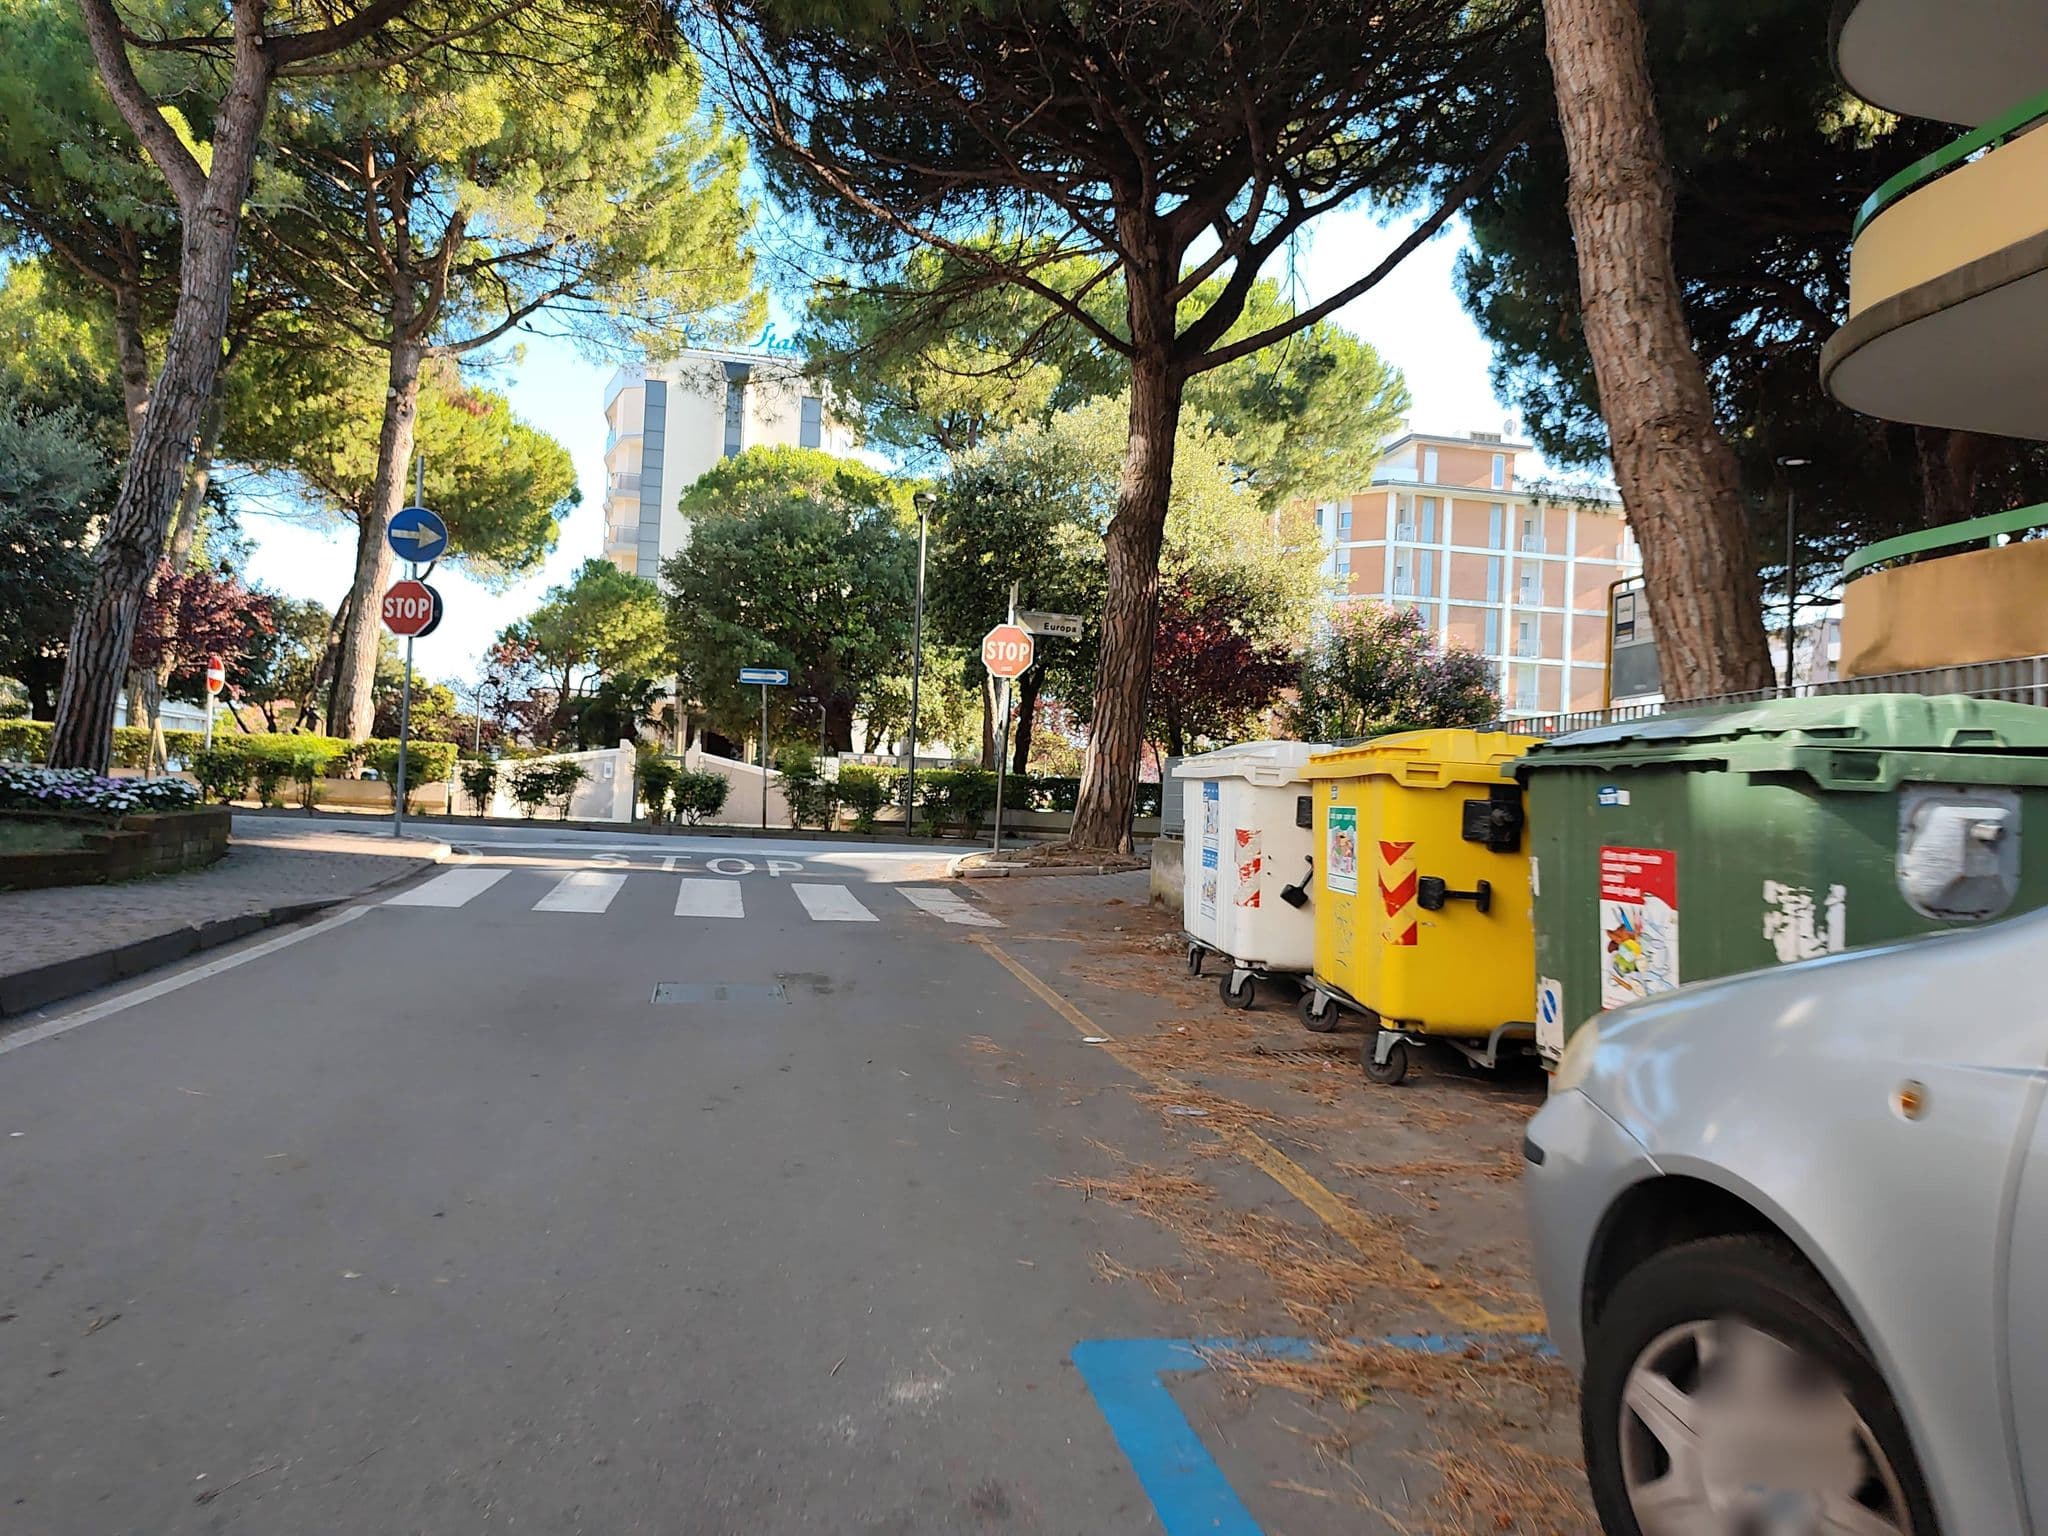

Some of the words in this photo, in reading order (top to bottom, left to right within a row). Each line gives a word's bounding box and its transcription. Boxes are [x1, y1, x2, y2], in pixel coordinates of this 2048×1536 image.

[384, 597, 430, 619] STOP
[1043, 622, 1077, 633] Europa
[986, 641, 1030, 662] STOP
[591, 853, 804, 877] STOP
